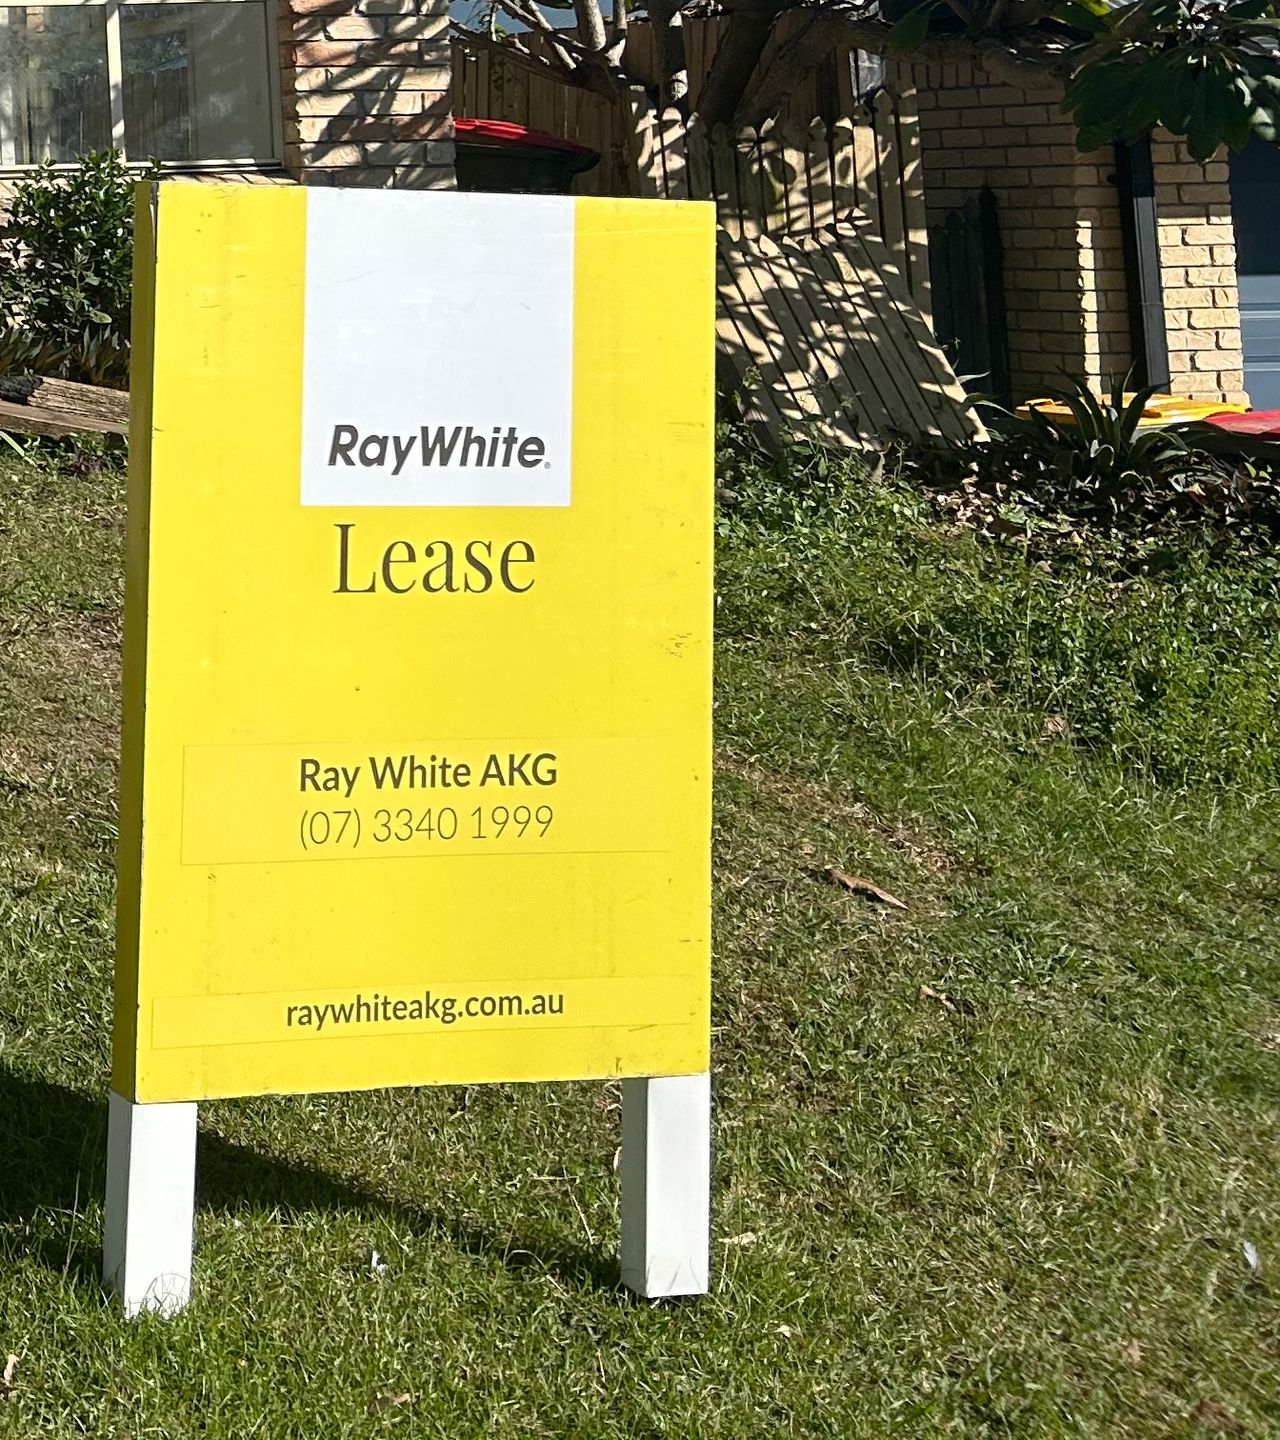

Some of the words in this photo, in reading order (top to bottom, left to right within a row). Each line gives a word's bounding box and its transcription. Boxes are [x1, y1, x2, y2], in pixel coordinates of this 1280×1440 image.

[333, 523, 535, 594] Lease
[300, 758, 361, 798] Ray
[368, 754, 472, 790] White
[478, 752, 557, 787] AKG
[300, 808, 361, 850] (07)
[372, 807, 458, 843] 3340
[470, 805, 553, 839] 1999
[287, 990, 564, 1032] raywhiteakg.com.au
